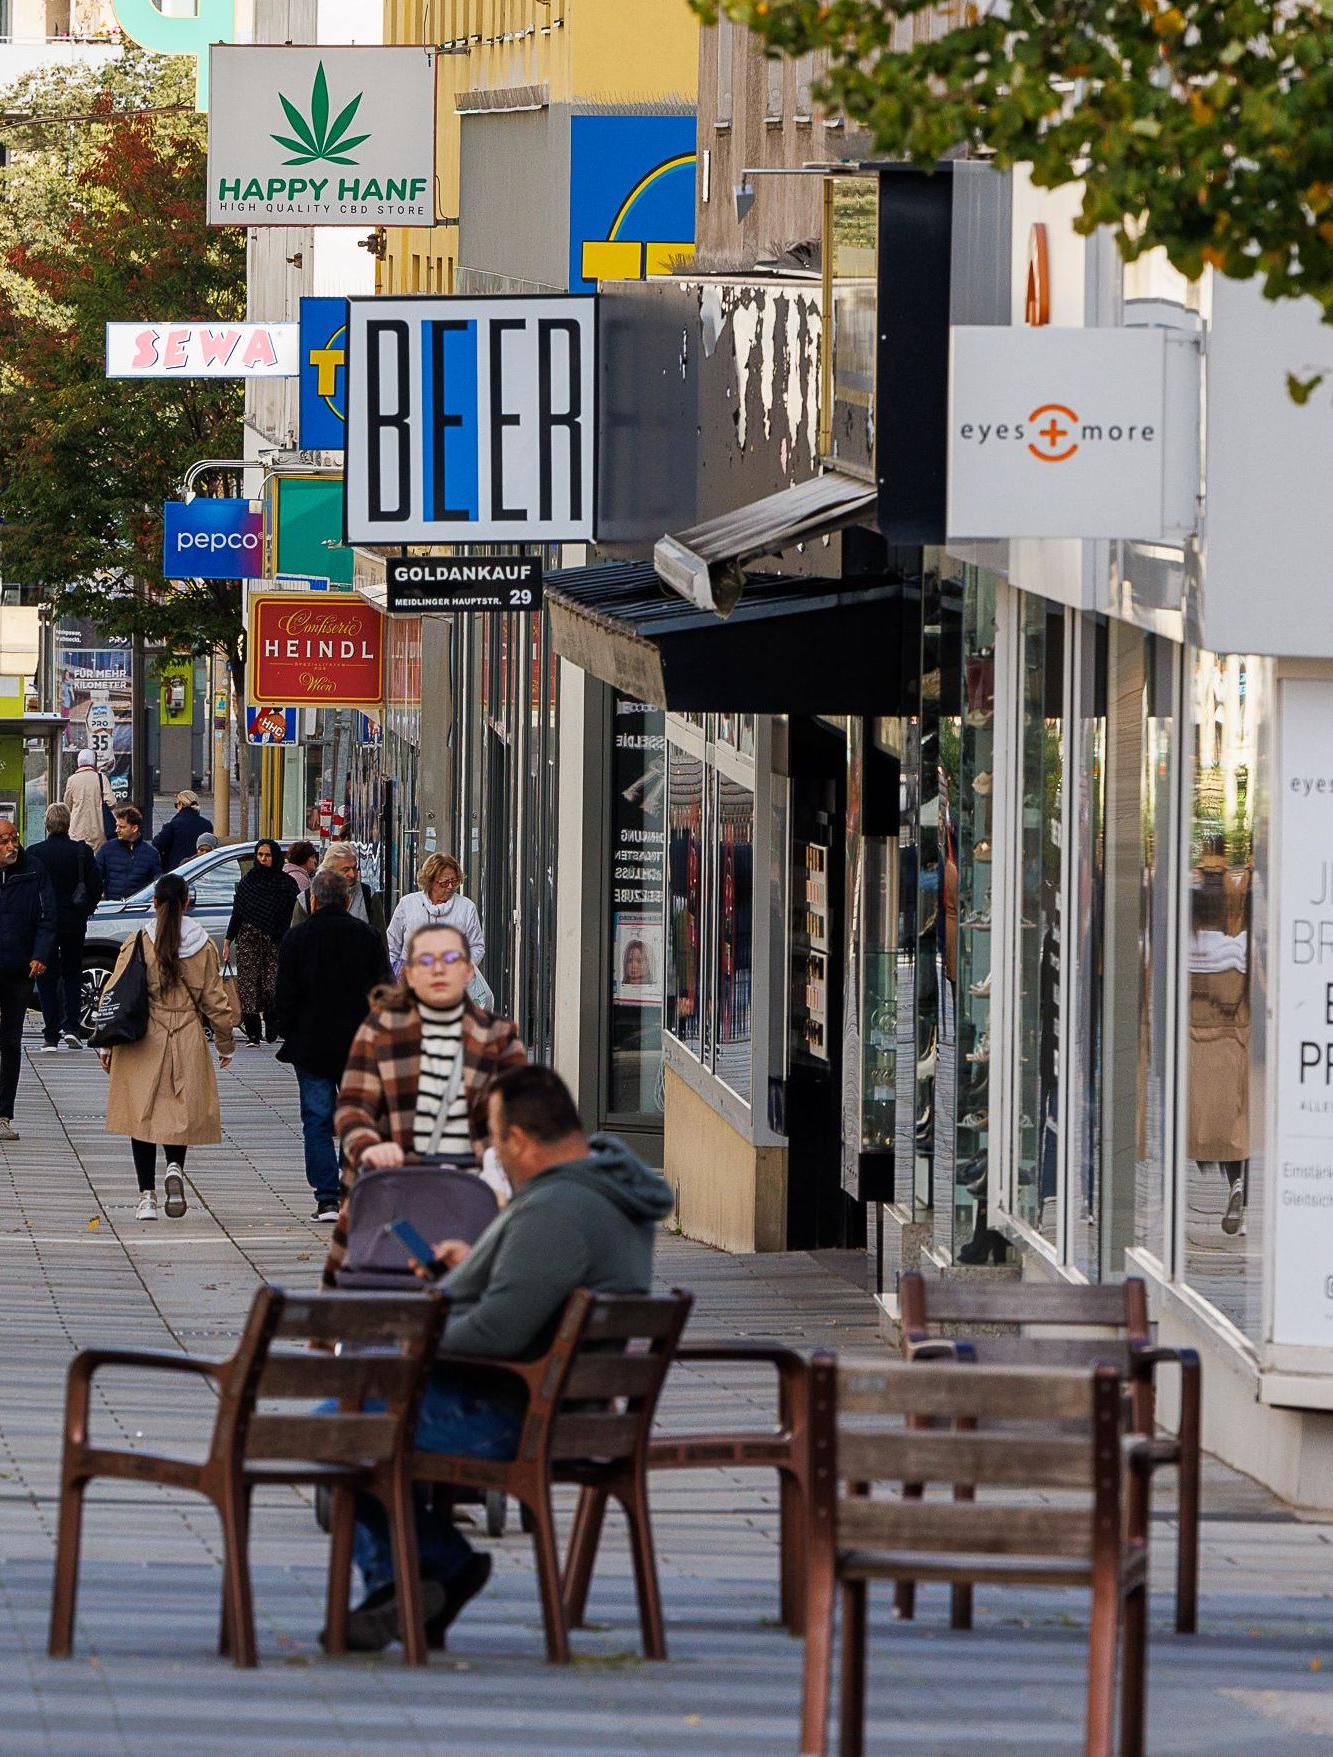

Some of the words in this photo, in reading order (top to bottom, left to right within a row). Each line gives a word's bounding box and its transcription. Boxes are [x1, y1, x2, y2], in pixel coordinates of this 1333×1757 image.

[219, 178, 329, 201] HAPPY
[338, 178, 427, 202] HANF
[220, 202, 256, 212] HIGH
[266, 204, 331, 214] QUALITY
[340, 206, 368, 214] CBD
[378, 206, 424, 215] STORE
[132, 329, 279, 370] SEWA
[367, 318, 582, 522] BEER
[960, 423, 1025, 445] eyes
[1081, 424, 1155, 441] more
[177, 531, 258, 553] pepco
[395, 566, 532, 582] GOLDANKAUF
[395, 598, 450, 607] MEIDLINGER
[452, 597, 502, 606] HAUPTSTR.
[509, 589, 532, 605] 29
[278, 608, 363, 636] Confiserie
[264, 640, 374, 660] HEINDL
[74, 668, 94, 678] FÜR
[97, 669, 127, 678] MEHR
[298, 672, 337, 693] Wien
[74, 681, 127, 689] KILOMETER
[91, 734, 109, 751] 35
